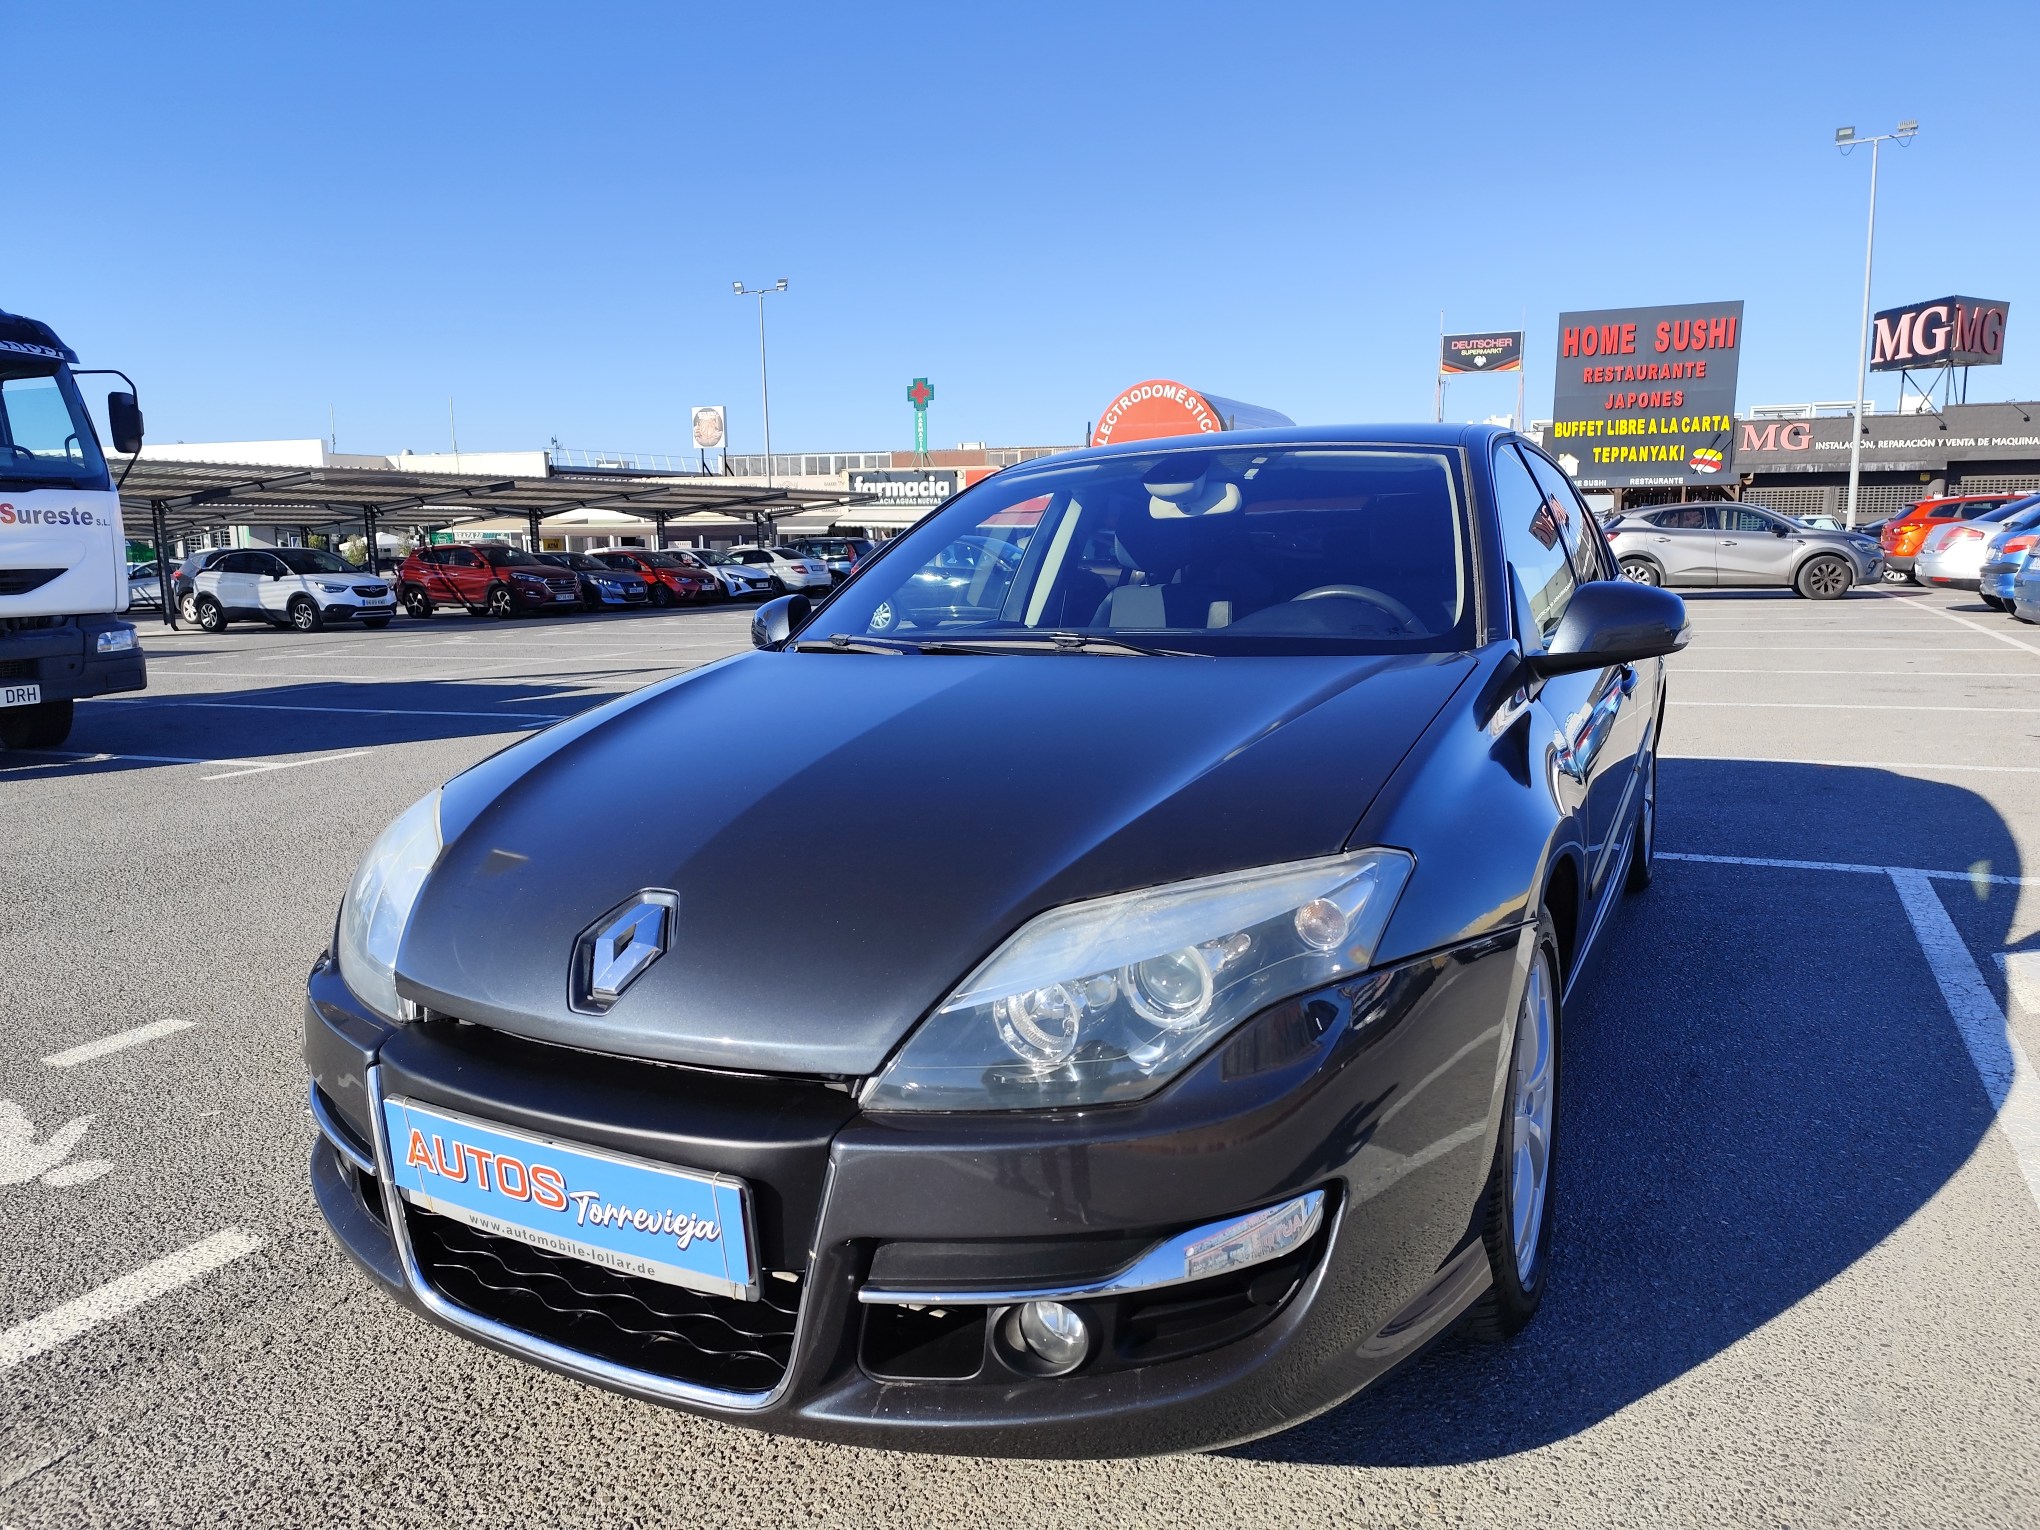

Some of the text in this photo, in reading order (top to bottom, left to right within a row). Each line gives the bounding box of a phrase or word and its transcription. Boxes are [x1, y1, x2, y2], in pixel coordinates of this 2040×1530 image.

[1563, 316, 1737, 357] HOME SUSHI
[1871, 305, 1951, 364] MG
[1953, 304, 2004, 355] MG
[1451, 338, 1513, 350] DEUTSCHER
[1583, 361, 1707, 383] RESTAURANTE
[1604, 390, 1684, 409] JAPONES
[1554, 415, 1730, 438] BUFFET LIBRE A LA CARTA
[1739, 423, 2040, 451] MG INSTALACÓN, REPARACIÓN Y VENTA DE MAQUINA
[1593, 445, 1685, 464] TEPPANYAKI
[854, 476, 949, 497] farmacia
[1583, 479, 1606, 487] SUSHI
[1630, 477, 1683, 485] RESTAURANTE
[918, 497, 941, 505] NUEVAS
[0, 503, 93, 525] Sureste
[6, 687, 36, 703] DRH
[406, 1128, 722, 1251] AUTOS Torrevieja
[469, 1214, 656, 1276] www.automobile-lollar.de
